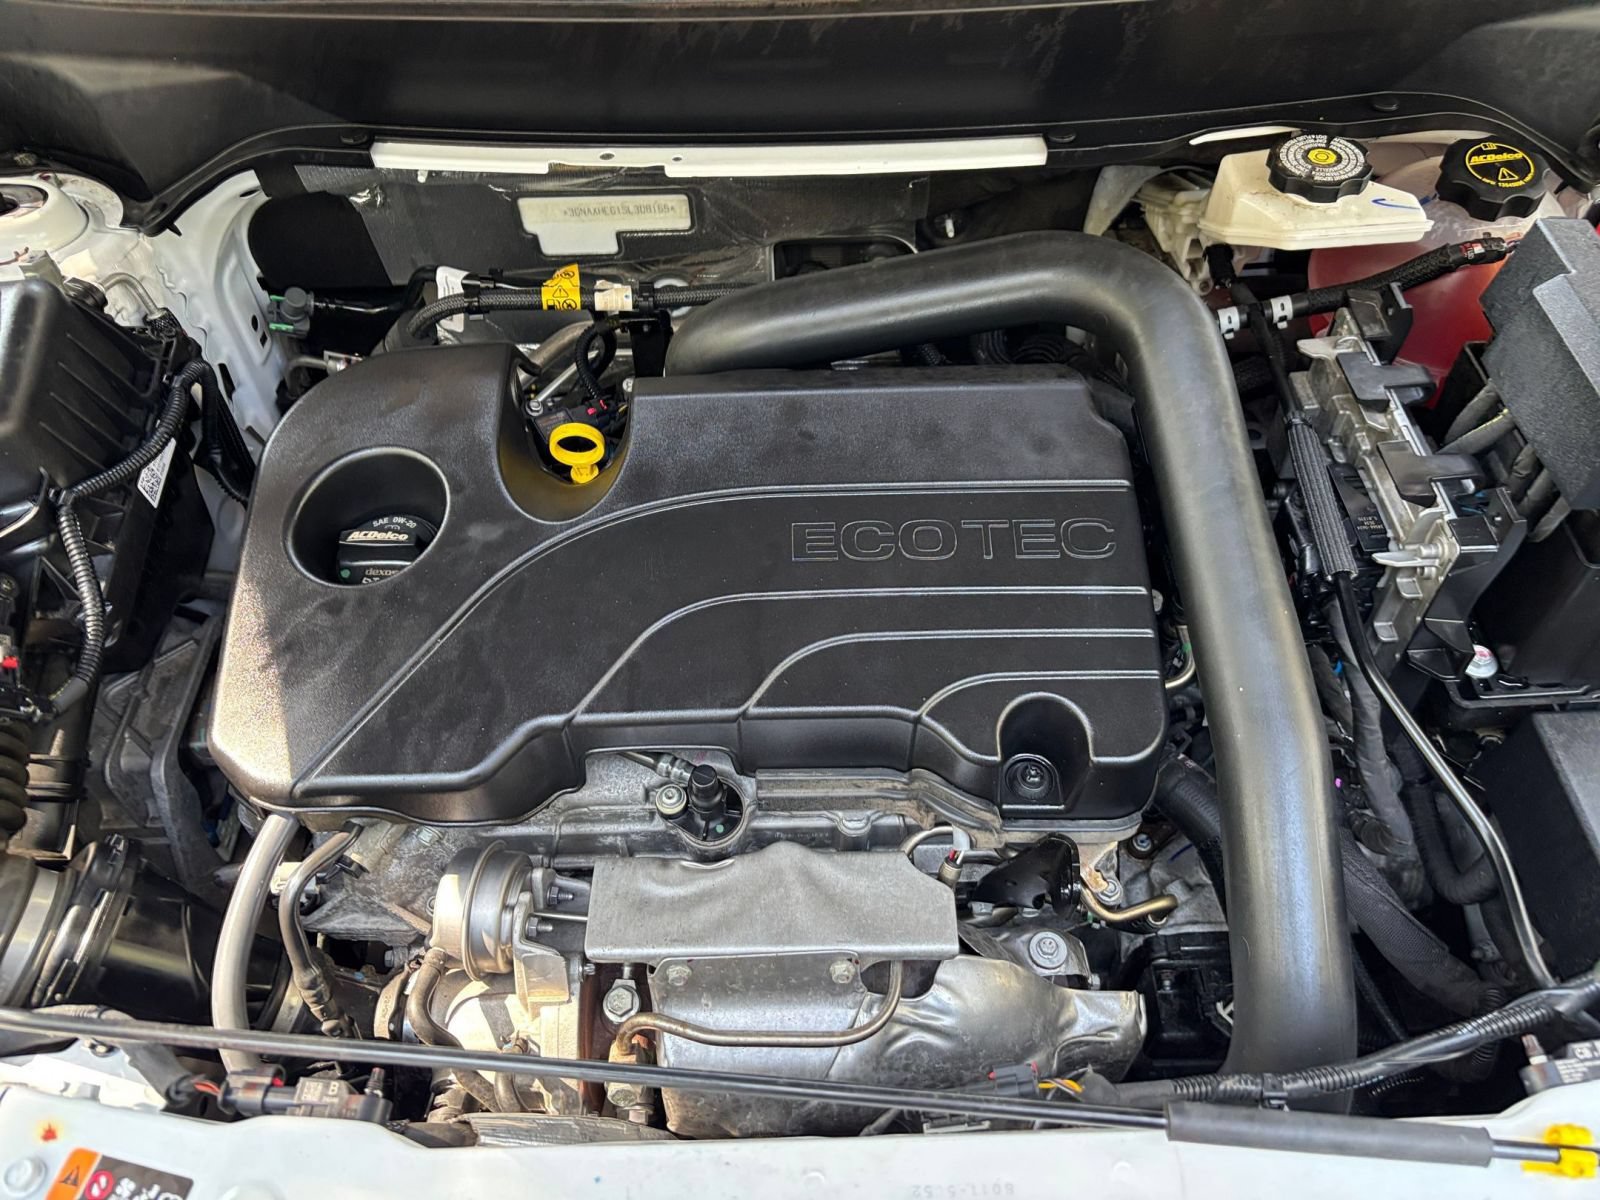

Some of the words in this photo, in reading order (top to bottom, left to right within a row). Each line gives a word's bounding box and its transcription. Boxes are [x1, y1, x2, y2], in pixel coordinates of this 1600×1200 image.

[1470, 152, 1523, 165] ACDelco
[372, 517, 389, 527] SAE
[392, 516, 417, 528] 0W-20
[345, 530, 409, 541] ACDelco
[791, 517, 1117, 561] ECOTEC
[329, 1081, 339, 1095] B
